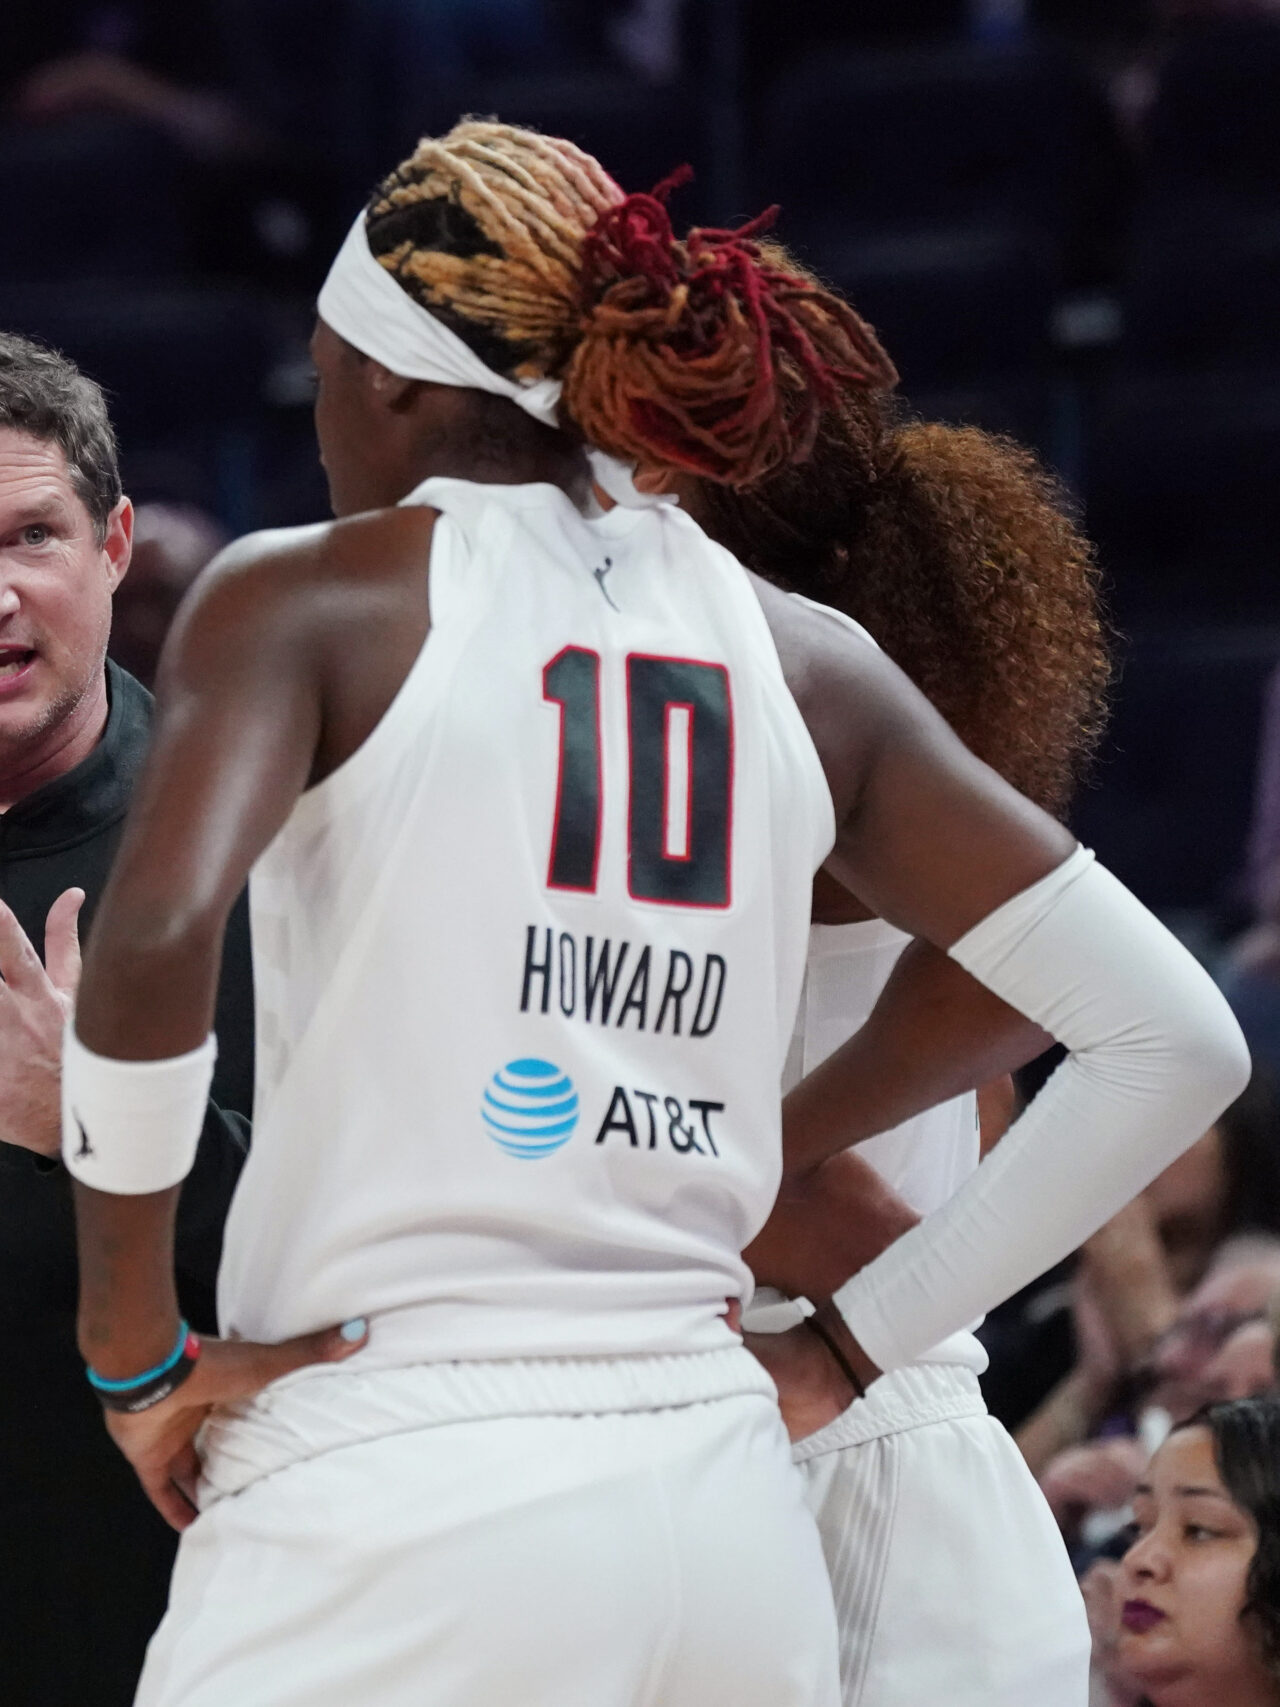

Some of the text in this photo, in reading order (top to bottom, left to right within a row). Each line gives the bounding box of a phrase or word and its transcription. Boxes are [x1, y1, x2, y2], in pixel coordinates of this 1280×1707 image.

[542, 644, 734, 909] 10
[519, 925, 727, 1038] HOWARD
[595, 1086, 725, 1158] AT&T
